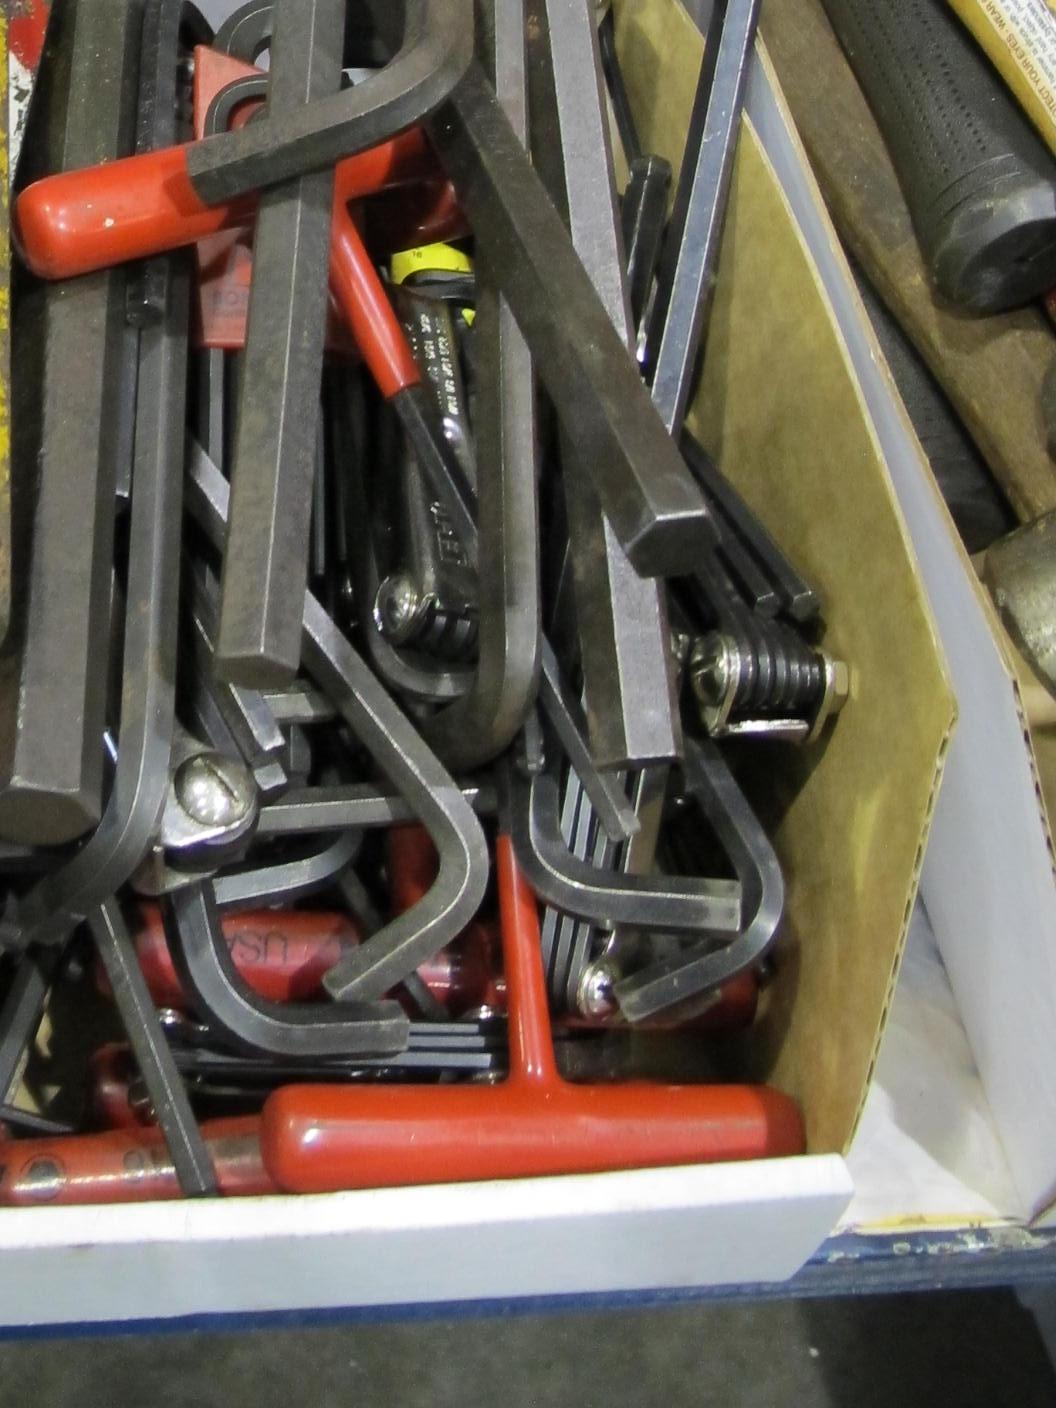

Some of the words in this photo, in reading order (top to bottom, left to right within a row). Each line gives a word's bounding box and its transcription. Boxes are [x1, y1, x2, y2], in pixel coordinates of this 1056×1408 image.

[984, 1, 1008, 30] WEAR
[1003, 32, 1027, 60] EYES
[1019, 57, 1043, 86] YOUR
